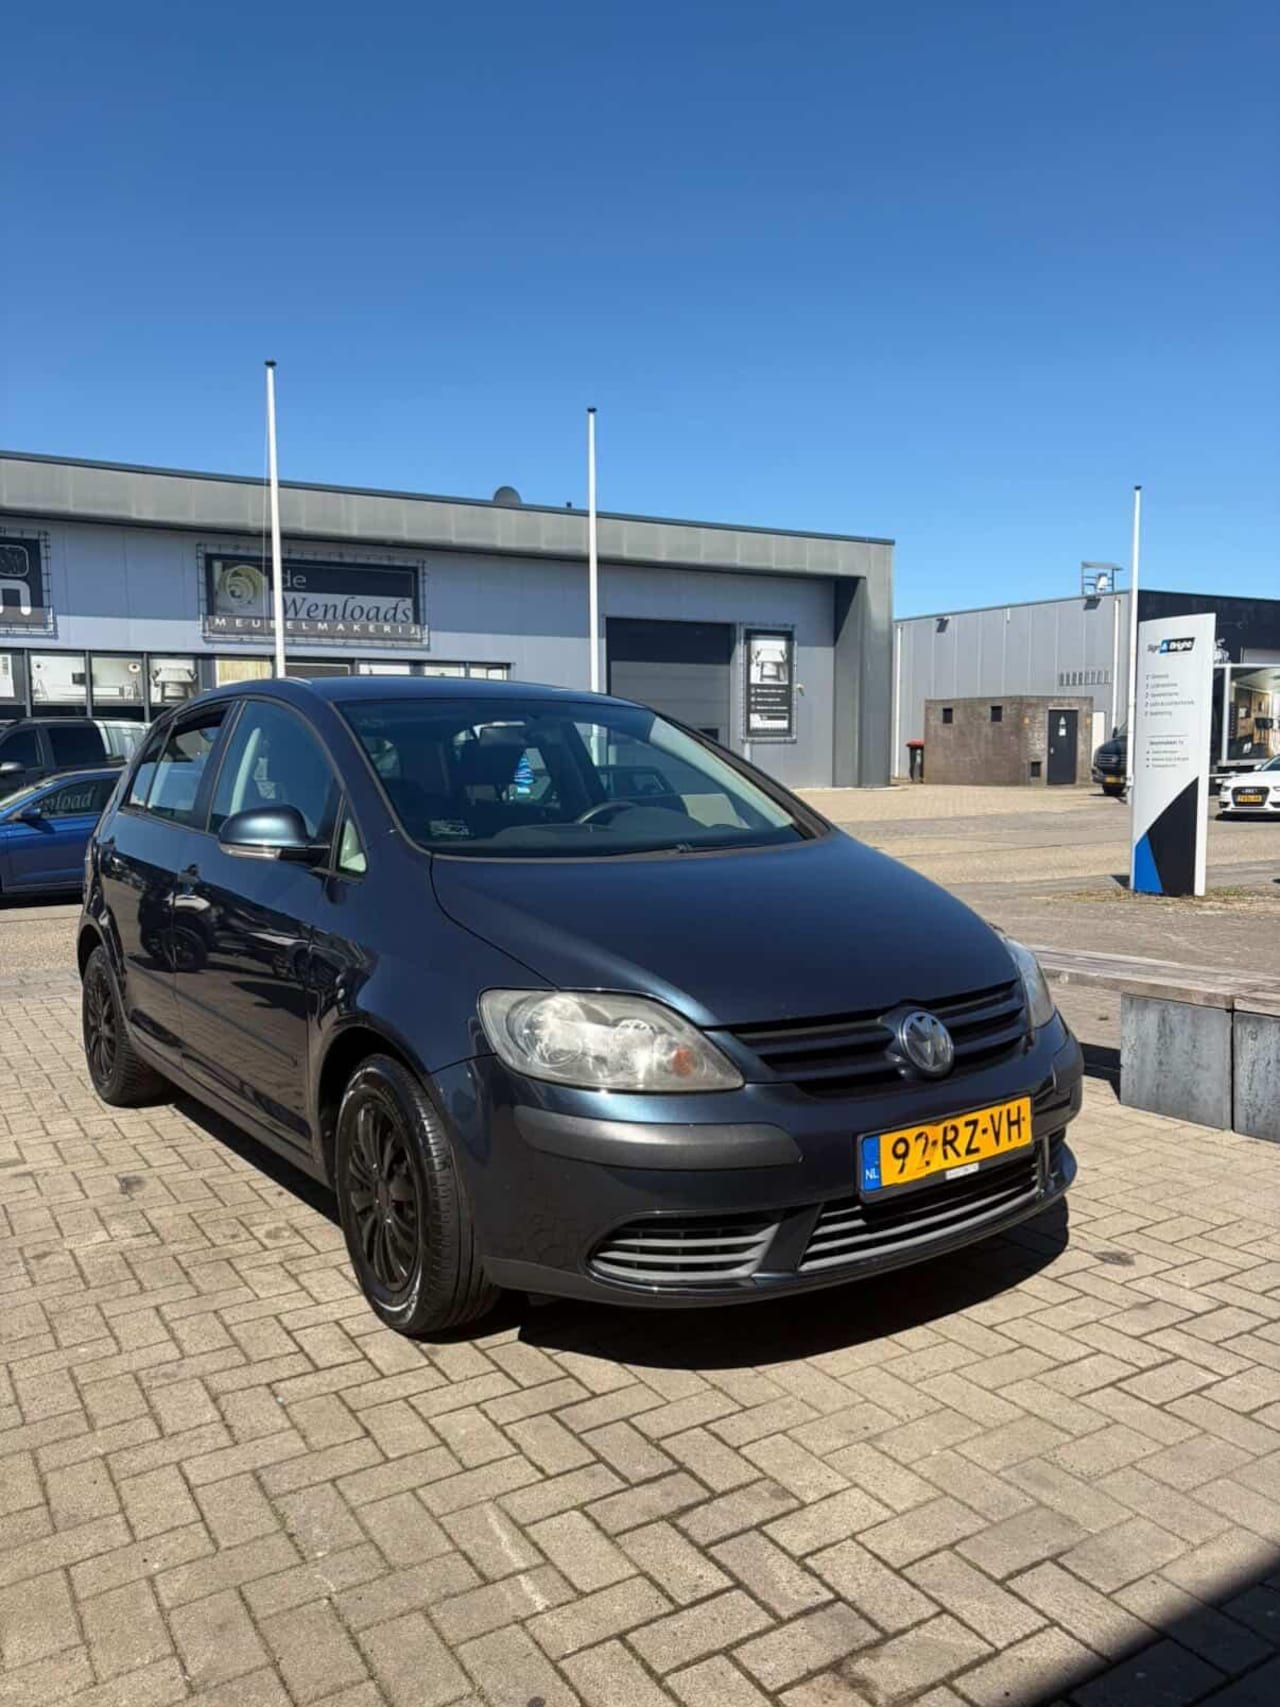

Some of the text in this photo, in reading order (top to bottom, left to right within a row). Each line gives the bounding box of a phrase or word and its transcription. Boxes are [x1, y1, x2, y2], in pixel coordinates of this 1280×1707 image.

[281, 569, 307, 589] de
[283, 595, 412, 623] Wenloads
[865, 1168, 879, 1180] NL
